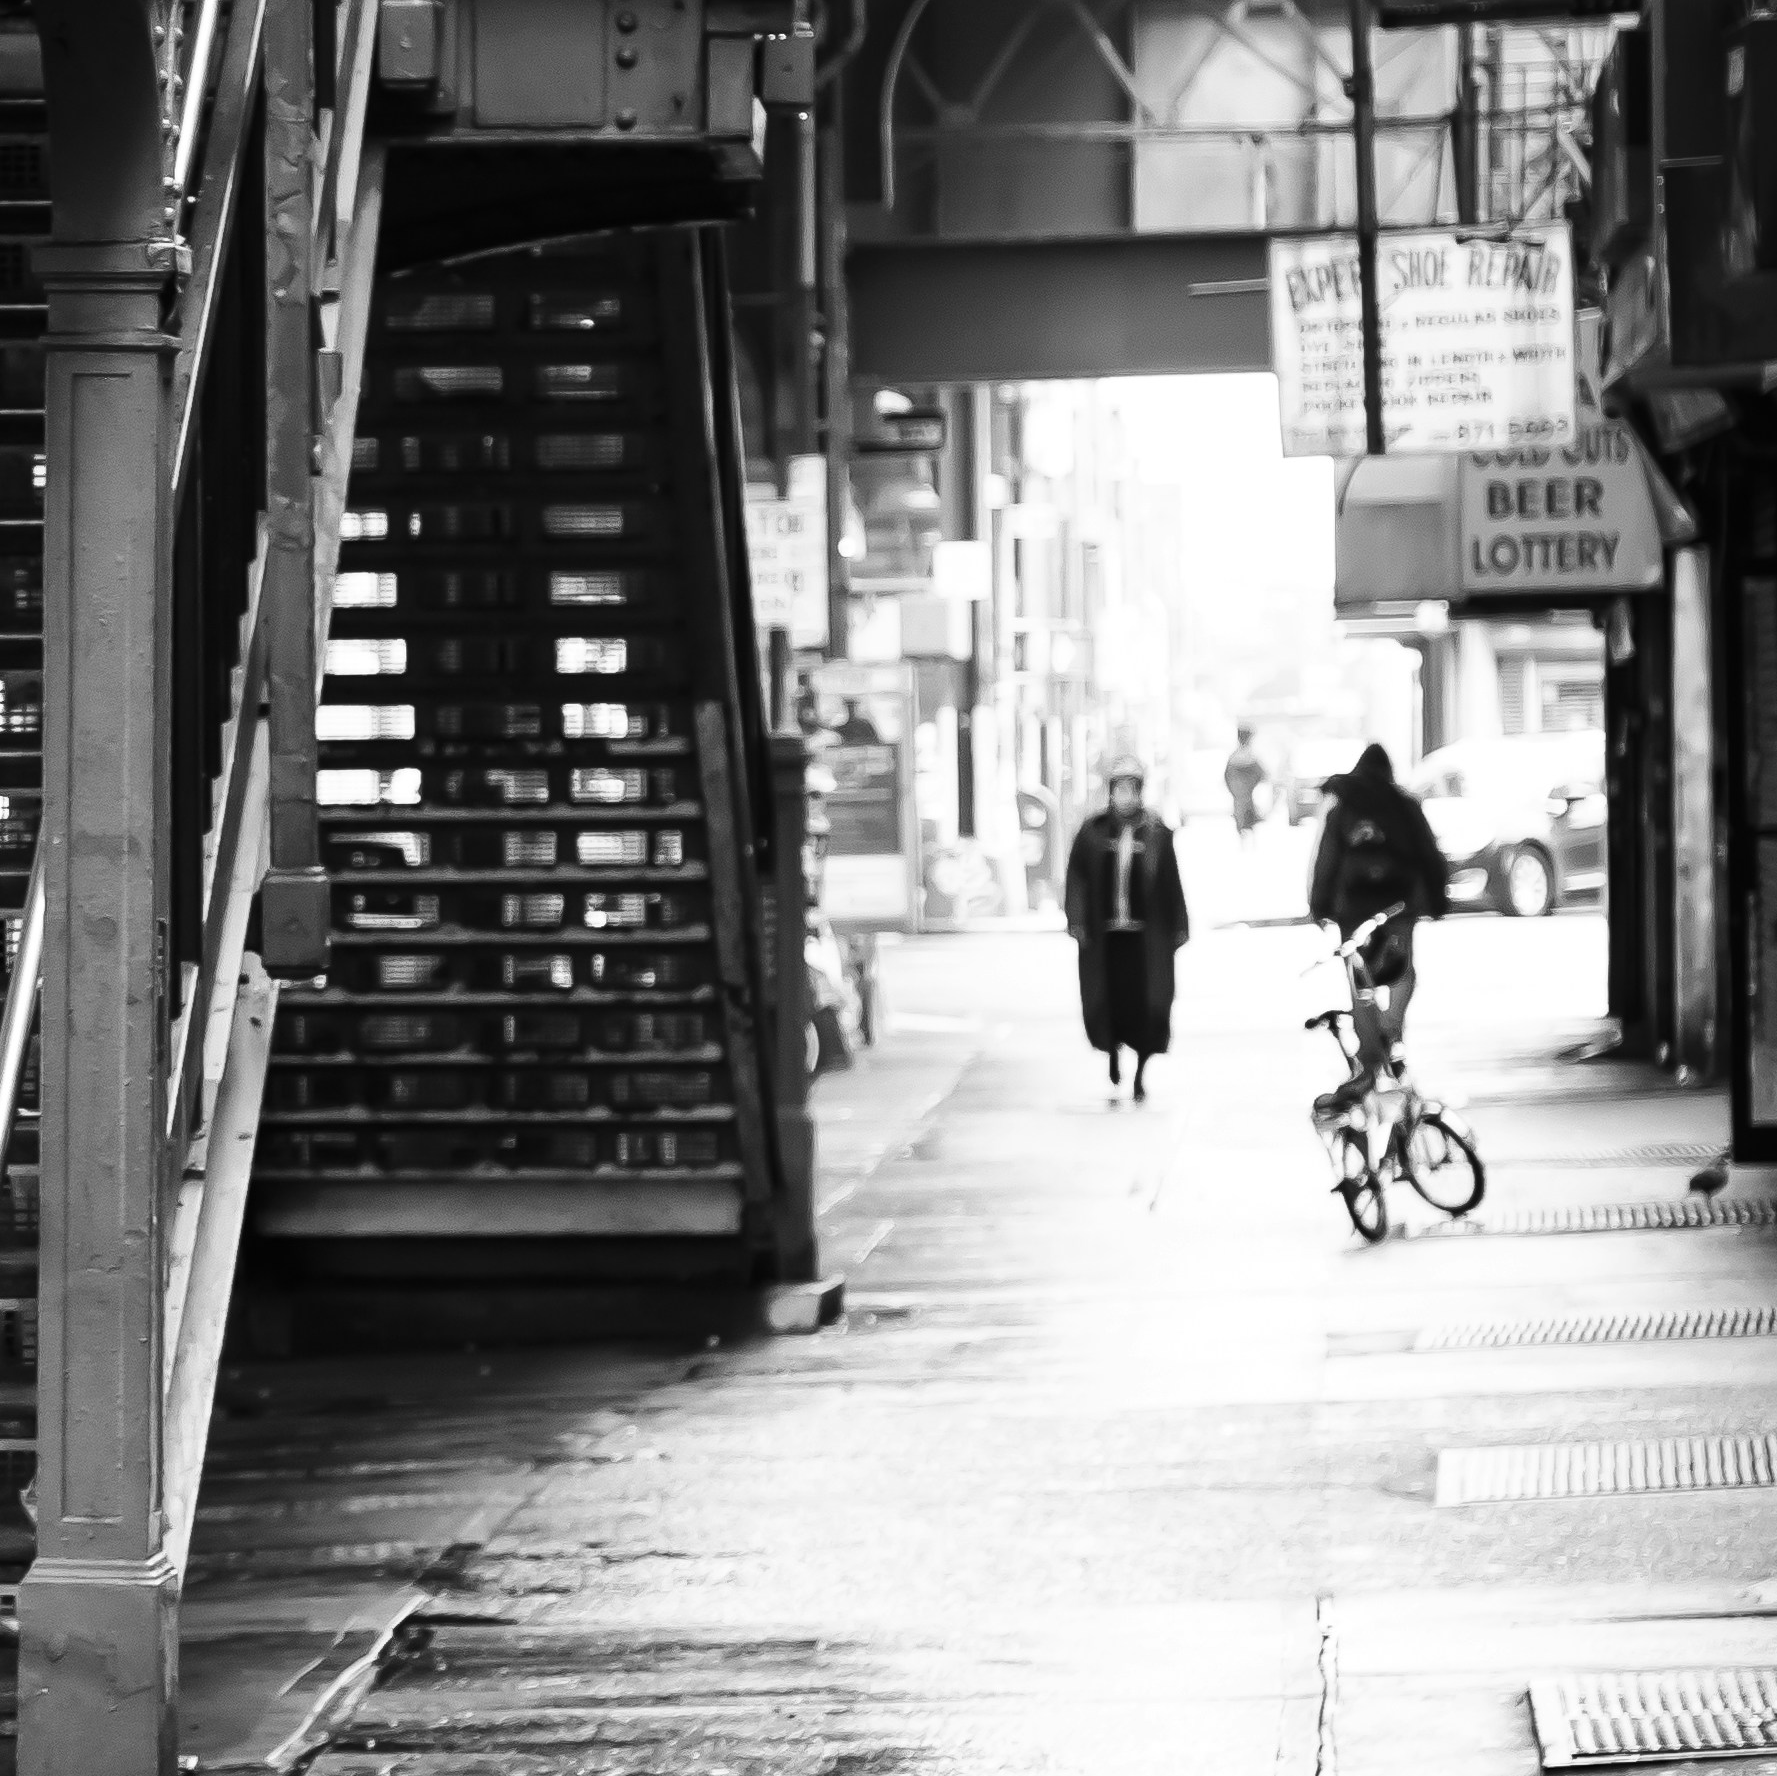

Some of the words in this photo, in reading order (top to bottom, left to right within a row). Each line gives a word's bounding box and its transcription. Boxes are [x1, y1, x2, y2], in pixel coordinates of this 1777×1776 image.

[1391, 247, 1451, 291] SHOE
[1468, 243, 1562, 295] REPAIR
[1487, 475, 1604, 521] BEER
[1474, 530, 1621, 576] LOTTERY
